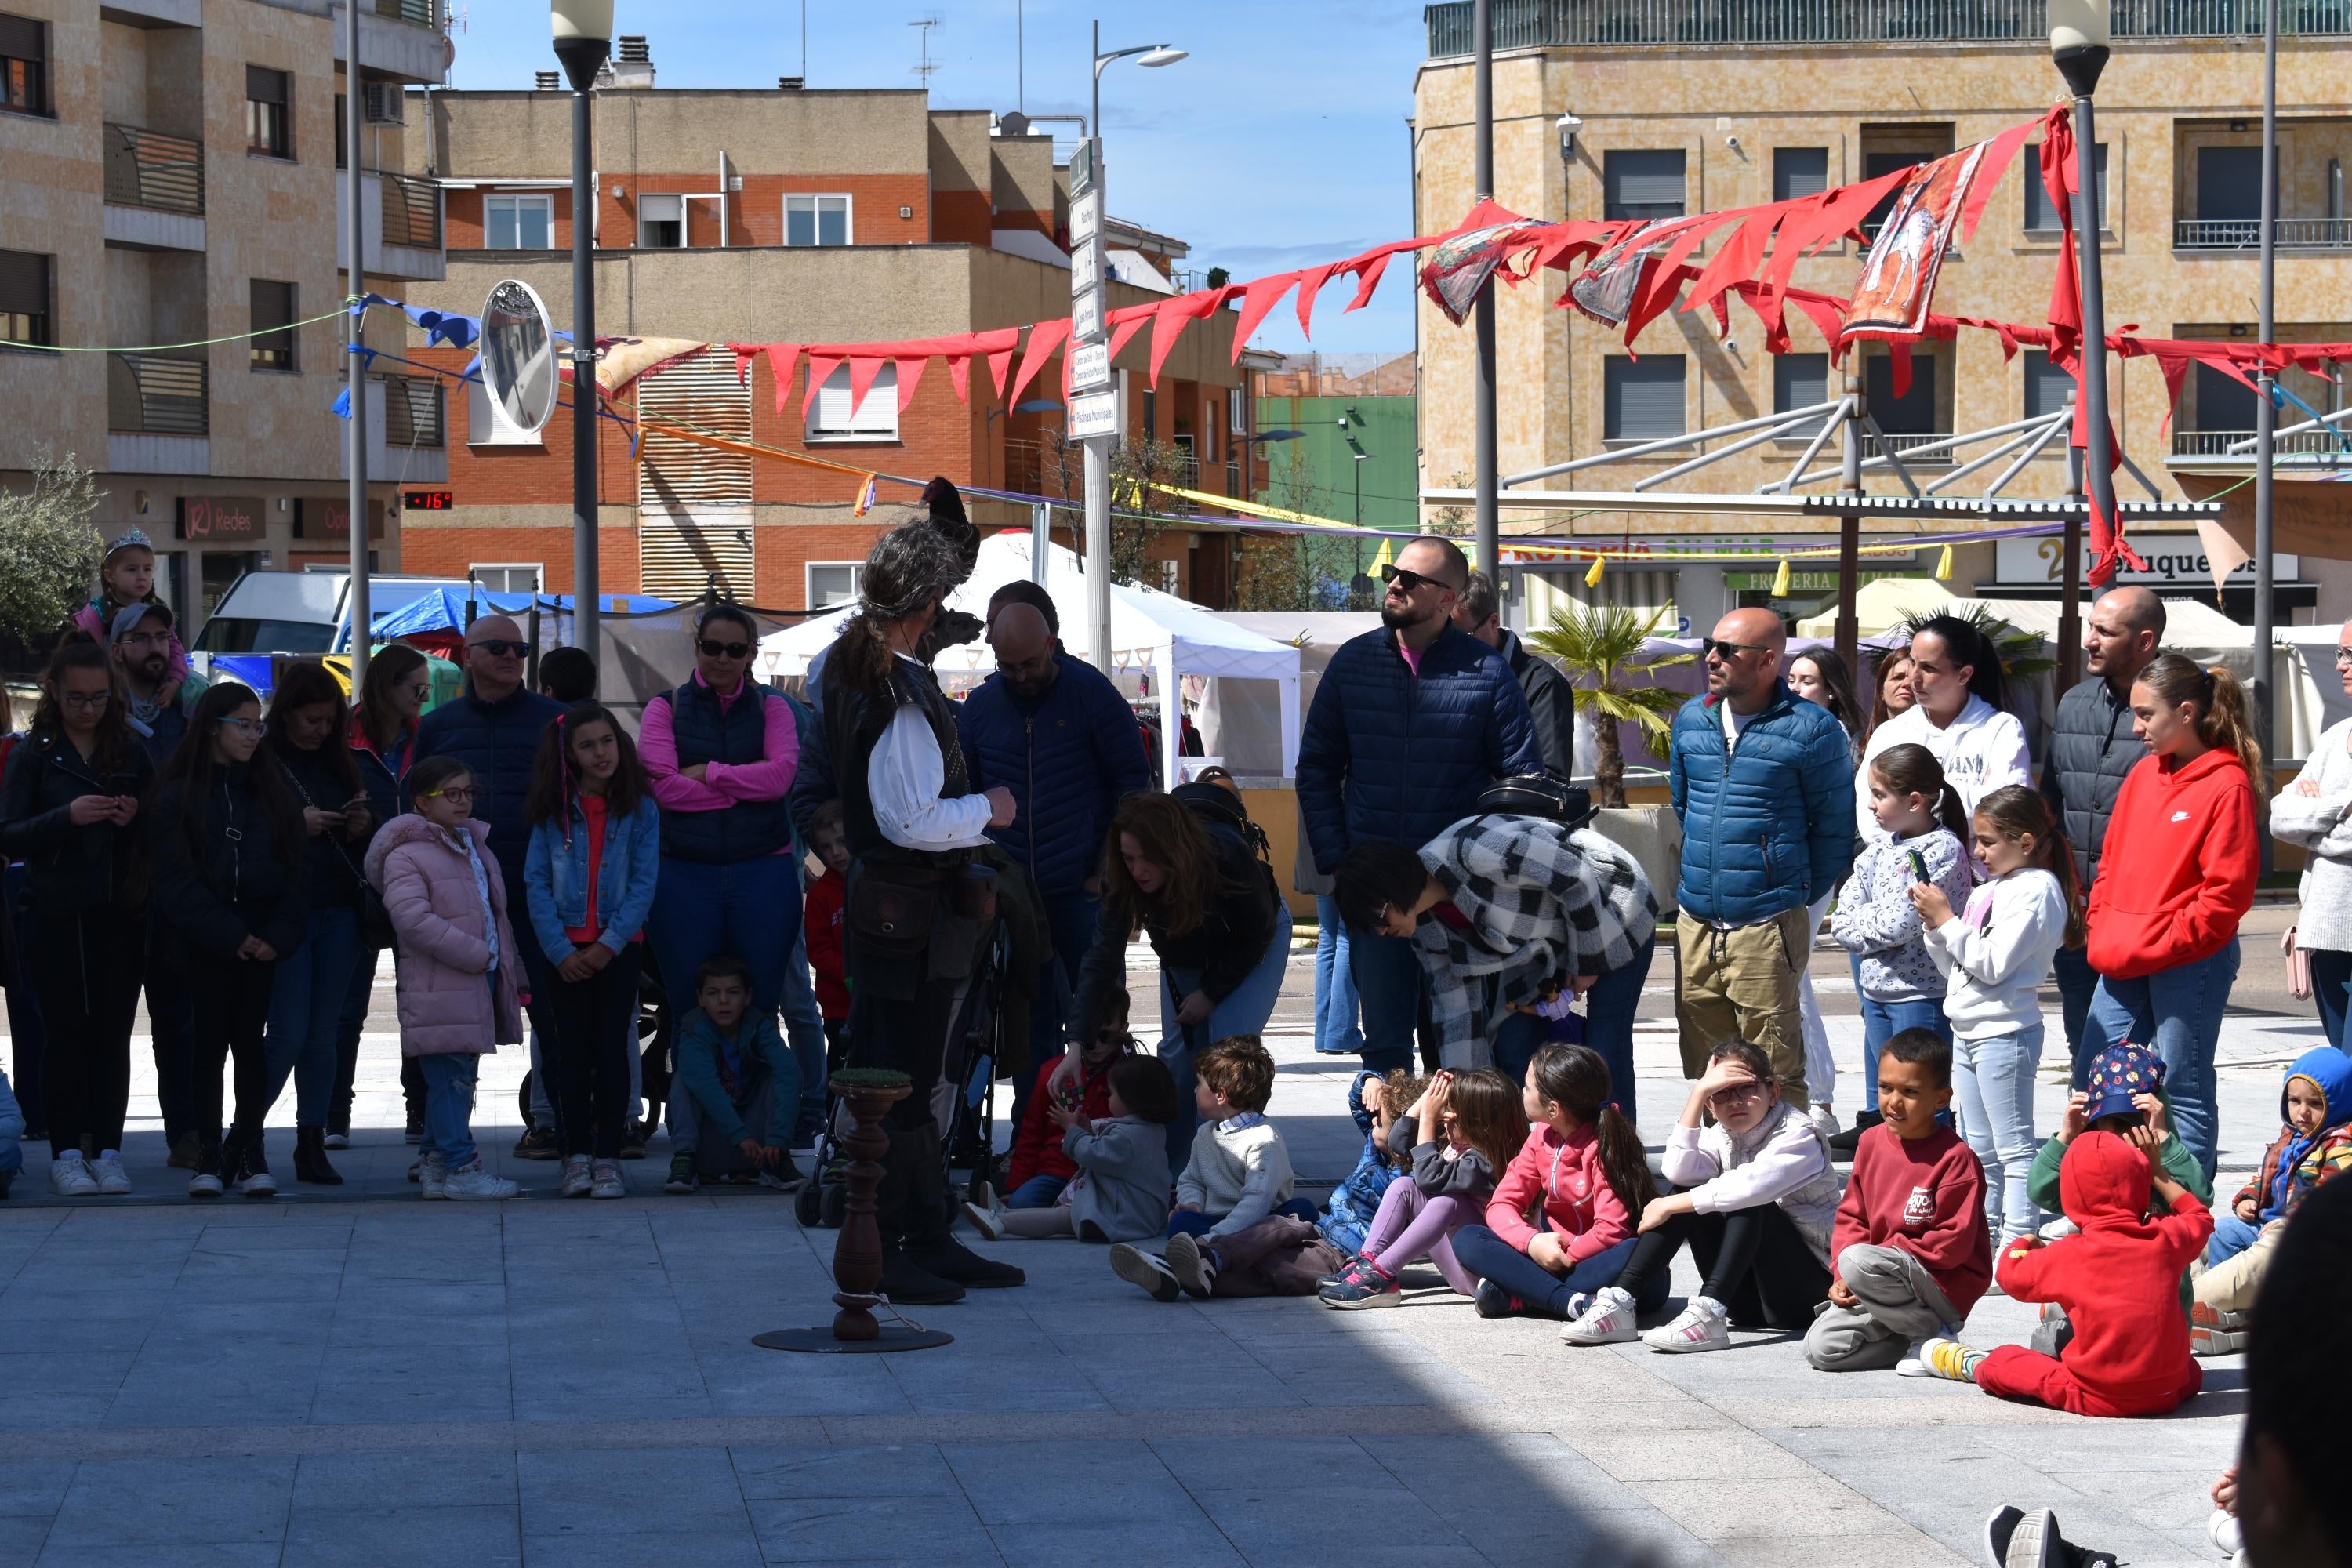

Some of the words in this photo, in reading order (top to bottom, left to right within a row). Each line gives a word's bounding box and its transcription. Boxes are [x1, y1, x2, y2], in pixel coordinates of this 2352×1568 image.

[1076, 412, 1091, 423] Piscinas
[1092, 408, 1113, 423] Municipales
[216, 506, 251, 531] Redes
[1749, 572, 1831, 589] FRUERIA
